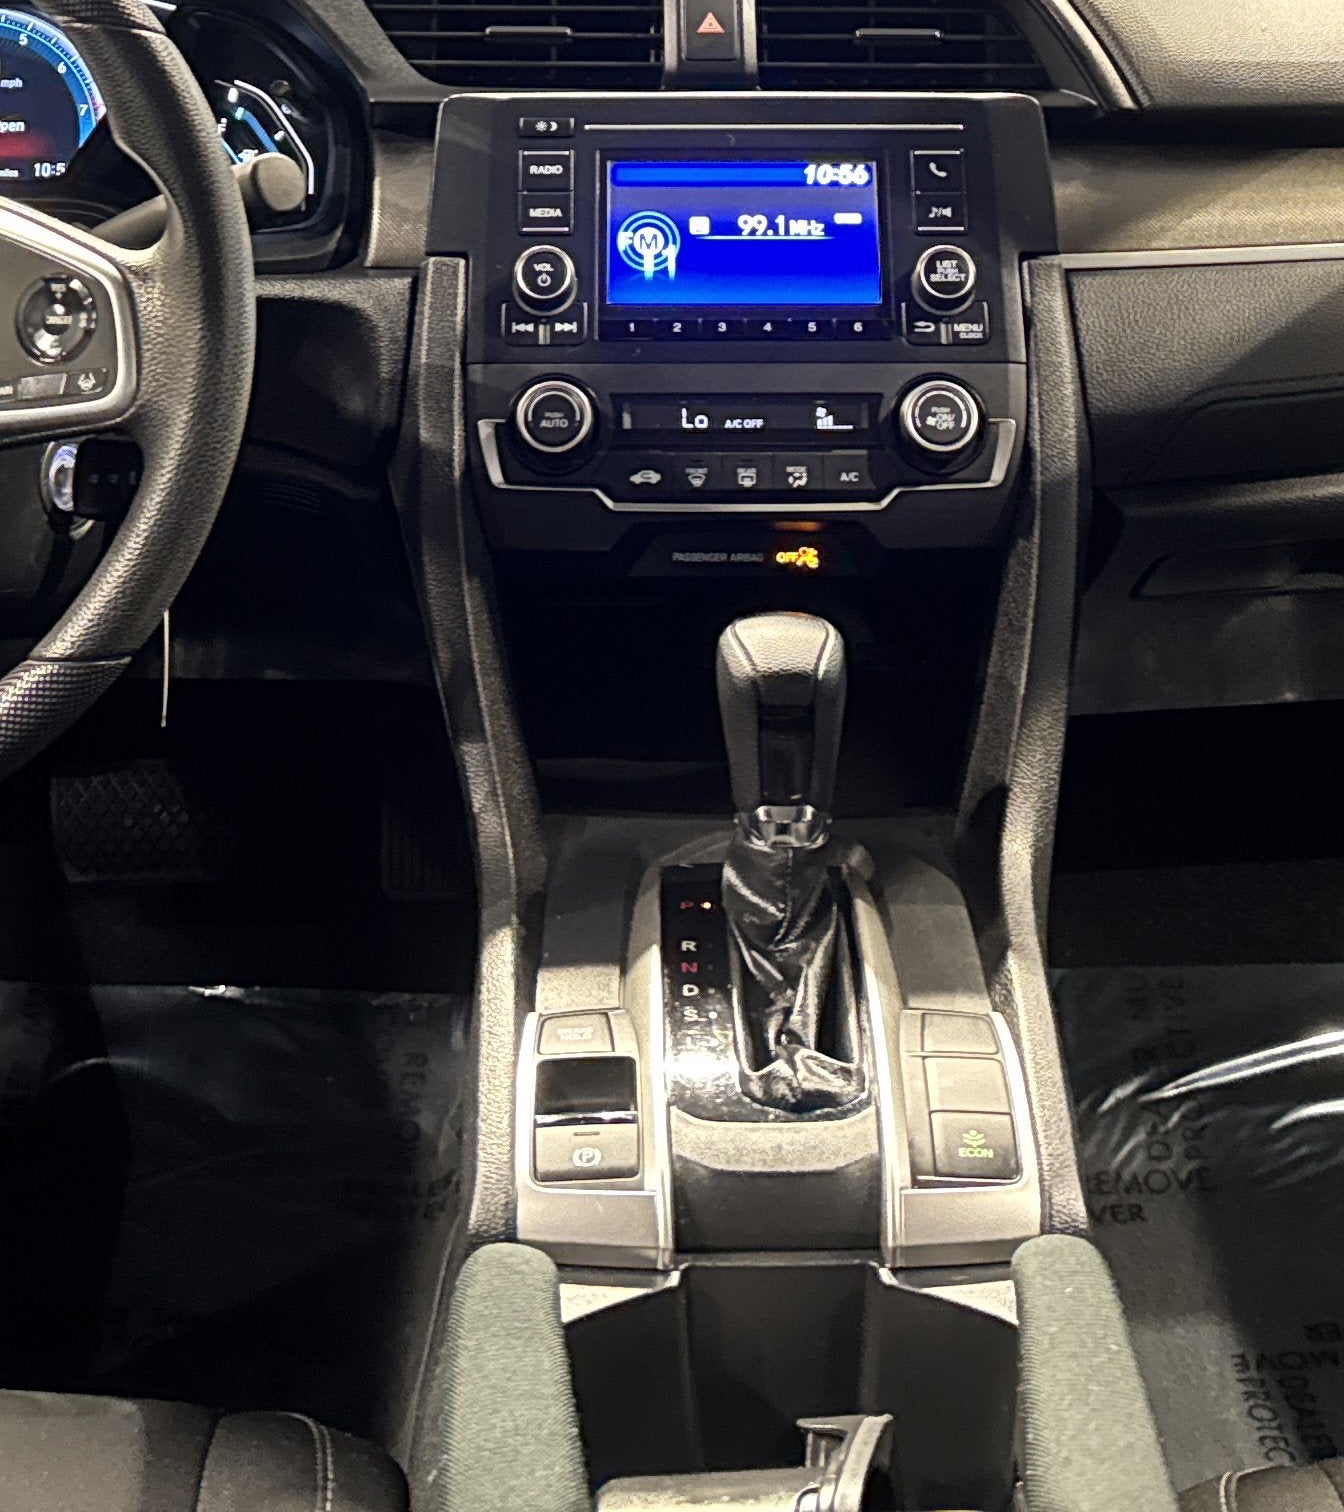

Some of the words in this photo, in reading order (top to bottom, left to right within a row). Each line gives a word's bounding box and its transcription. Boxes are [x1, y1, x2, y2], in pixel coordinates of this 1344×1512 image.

[17, 33, 30, 47] 5
[56, 61, 68, 75] 6
[0, 77, 24, 90] mph
[79, 103, 90, 118] 7
[529, 164, 564, 176] RADIO
[803, 163, 870, 186] 10:56
[529, 207, 563, 218] MEDIA
[737, 214, 787, 237] 99.1
[789, 219, 825, 237] MHz
[533, 262, 555, 272] VOL
[929, 273, 967, 283] SELECT
[628, 322, 636, 333] 1
[672, 322, 683, 333] 2
[717, 322, 728, 333] 3
[762, 322, 774, 333] 4
[807, 322, 818, 333] 5
[853, 322, 864, 333] 6
[953, 322, 984, 332] MENU
[539, 418, 569, 429] AUTO
[681, 407, 709, 430] Lo
[724, 417, 743, 430] A/C
[743, 417, 764, 430] OFF
[839, 471, 859, 482] A/C
[671, 552, 728, 563] PASSENGER
[729, 552, 764, 563] AIRBAG
[775, 551, 799, 564] OFF
[681, 939, 698, 953] R
[681, 961, 698, 974] N
[682, 983, 700, 997] D
[683, 1008, 699, 1023] S
[958, 1147, 994, 1160] ECON
[1086, 1168, 1218, 1194] EMOVE
